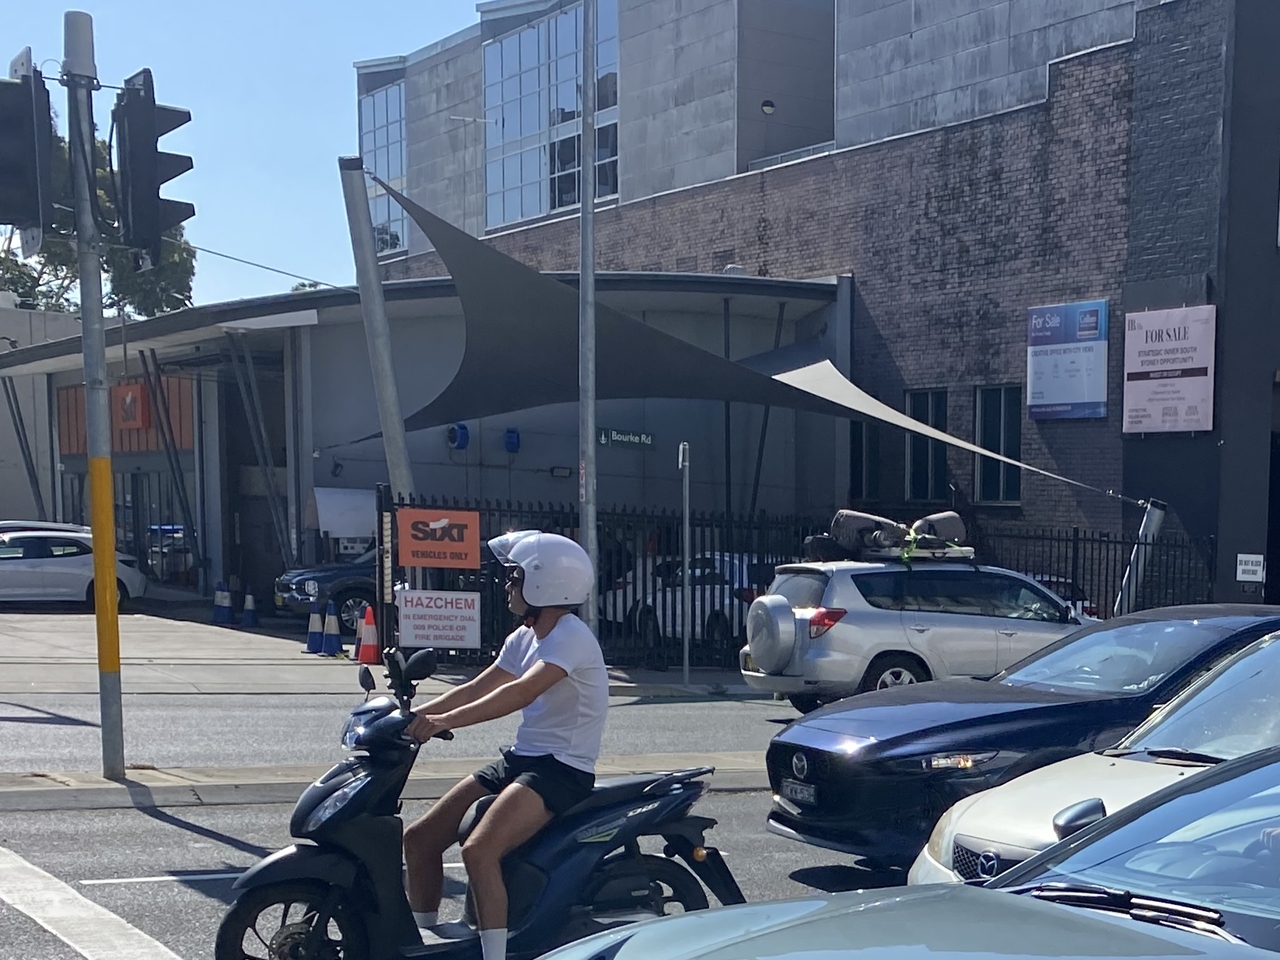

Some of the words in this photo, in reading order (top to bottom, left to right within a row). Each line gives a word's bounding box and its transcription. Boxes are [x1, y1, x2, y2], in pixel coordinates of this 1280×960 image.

[1032, 315, 1044, 329] For
[1045, 313, 1061, 328] Sale
[1145, 329, 1164, 344] FOR
[1166, 326, 1189, 342] SALE
[1138, 349, 1163, 357] STRATEGIC
[1164, 347, 1179, 355] INNER
[1180, 346, 1197, 354] SOUTH
[1141, 359, 1159, 367] SYDNEY
[1160, 356, 1194, 366] OPPORTUNITY
[611, 430, 640, 443] Bourke
[640, 433, 652, 444] Rd
[411, 550, 447, 560] VEHICLES
[450, 552, 469, 560] ONLY
[404, 596, 475, 610] HAZCHEM
